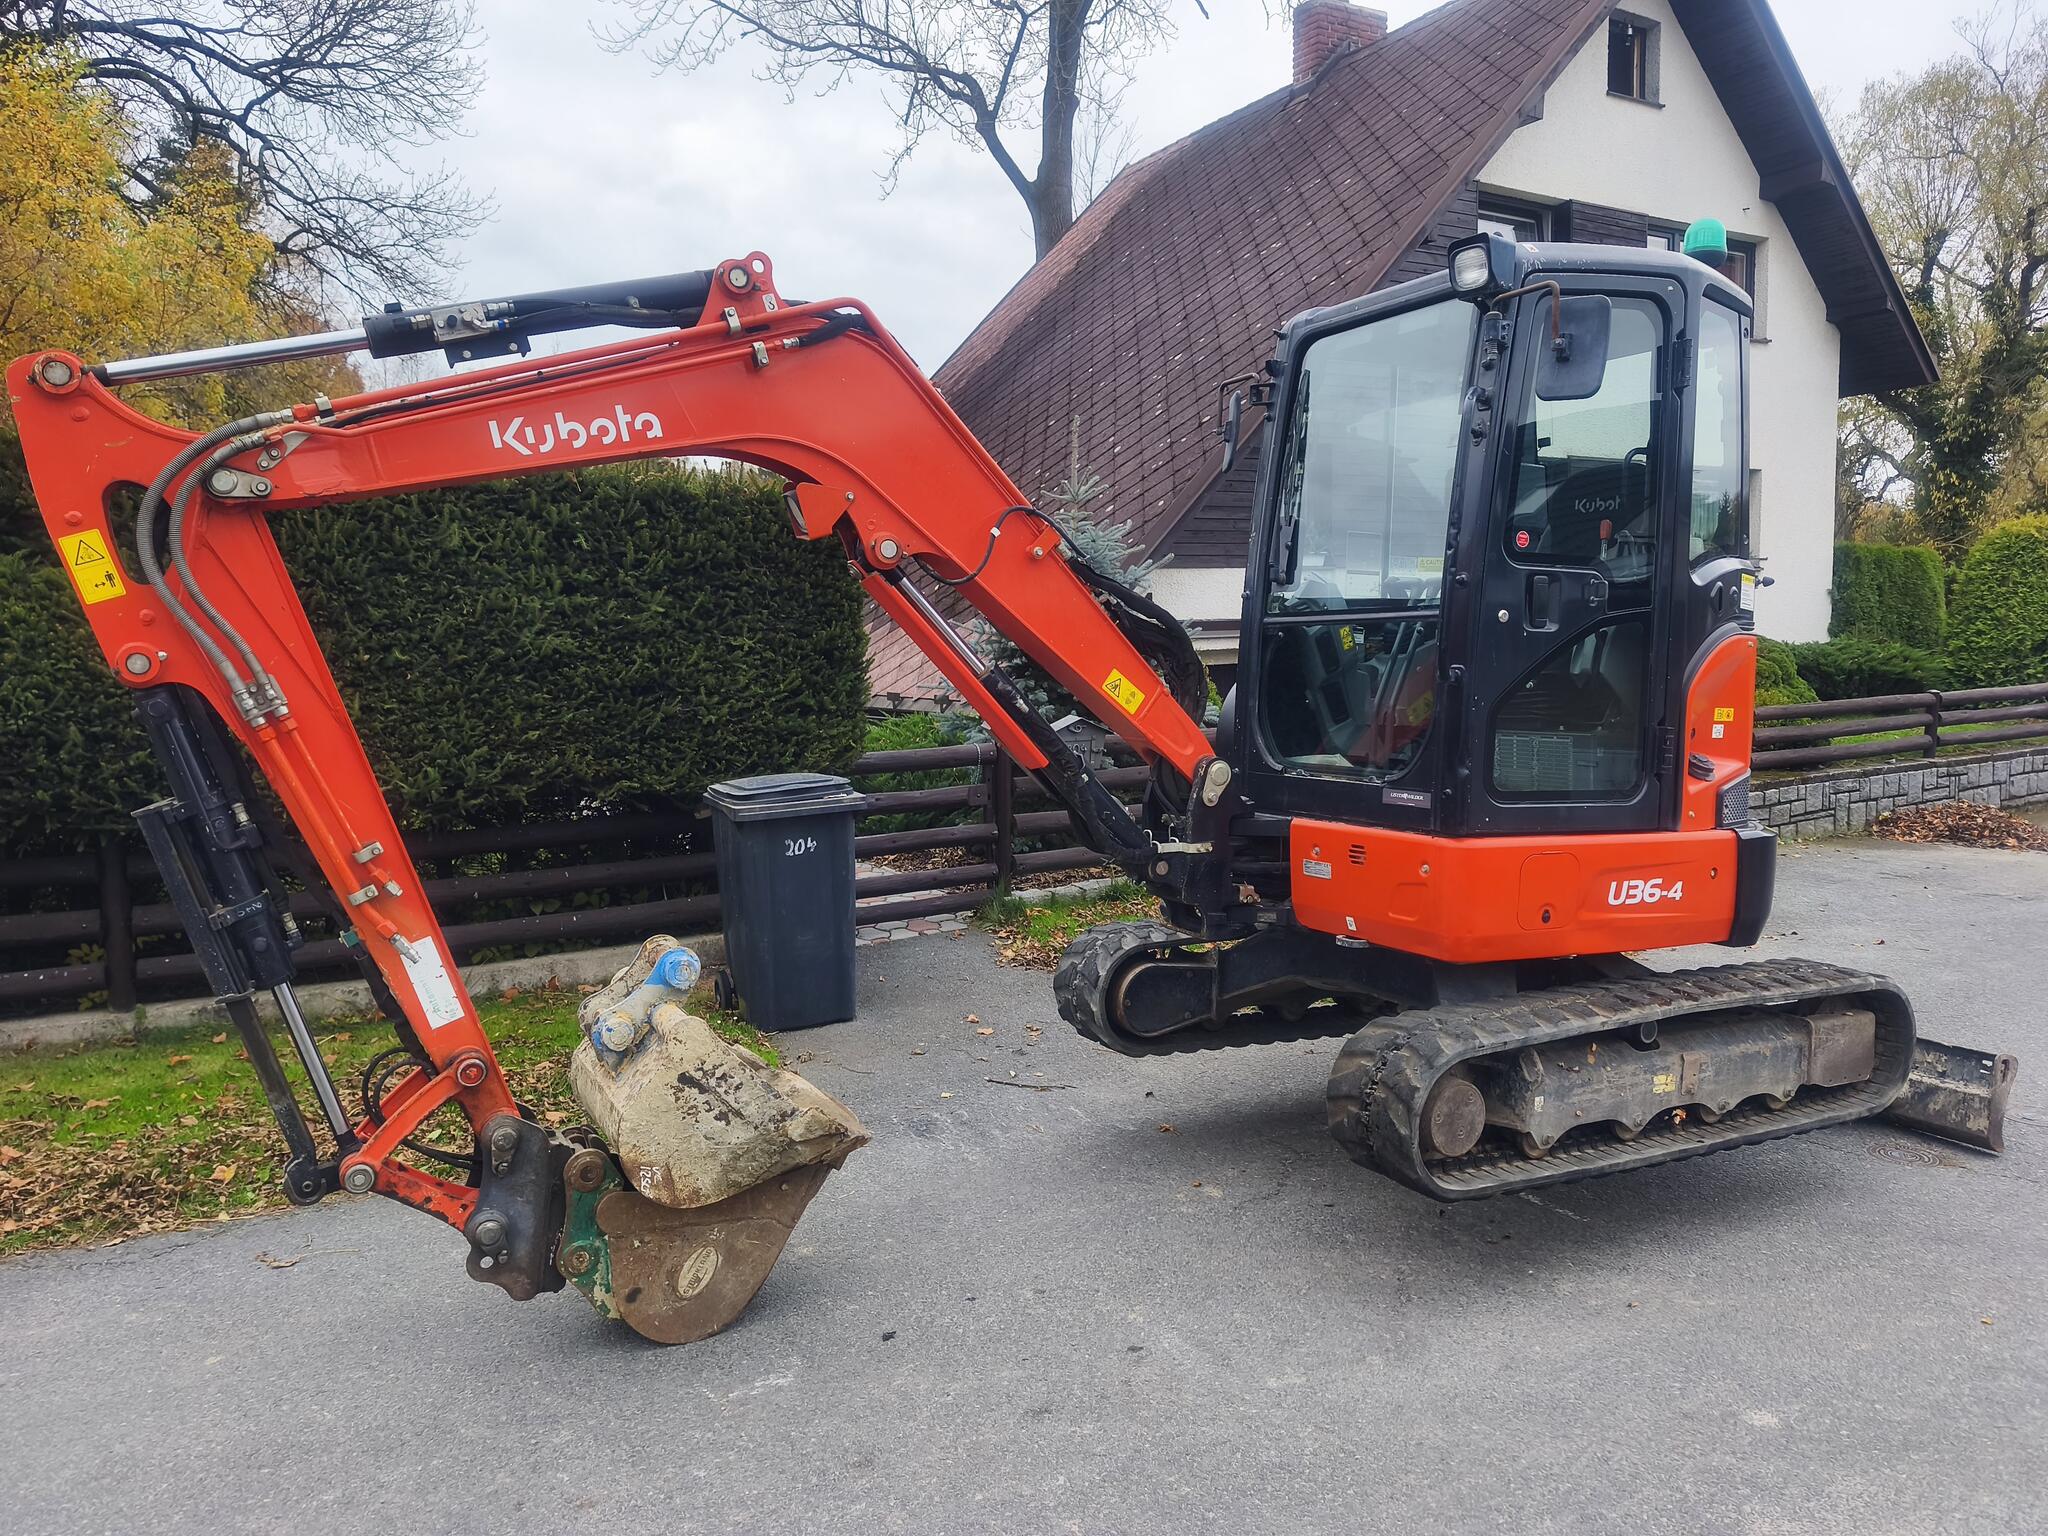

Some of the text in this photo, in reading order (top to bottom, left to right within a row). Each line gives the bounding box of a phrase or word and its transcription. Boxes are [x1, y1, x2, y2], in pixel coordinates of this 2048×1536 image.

[488, 404, 664, 456] Kubota
[1574, 495, 1621, 513] Kubot
[784, 836, 817, 857] 204
[1607, 877, 1684, 906] U36-4
